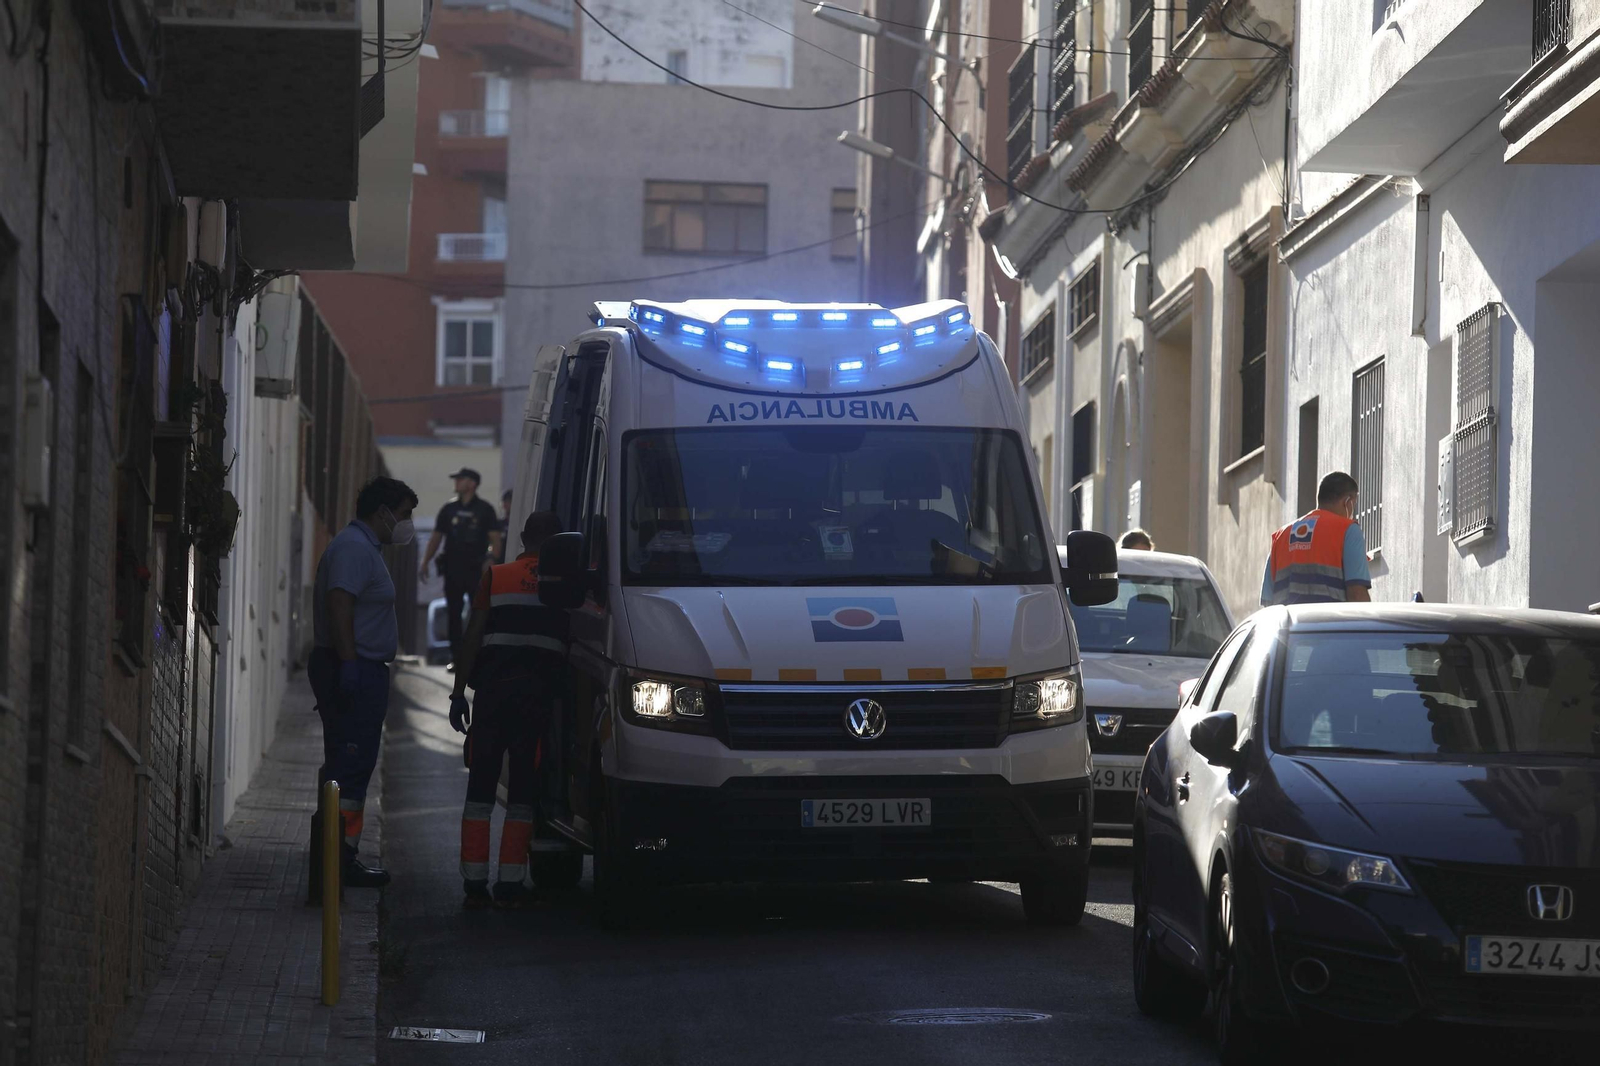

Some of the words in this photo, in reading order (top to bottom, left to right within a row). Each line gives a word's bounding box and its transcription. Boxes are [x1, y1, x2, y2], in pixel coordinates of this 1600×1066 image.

[817, 802, 874, 824] 4529
[882, 802, 924, 823] LVR
[1487, 941, 1566, 971] 3244
